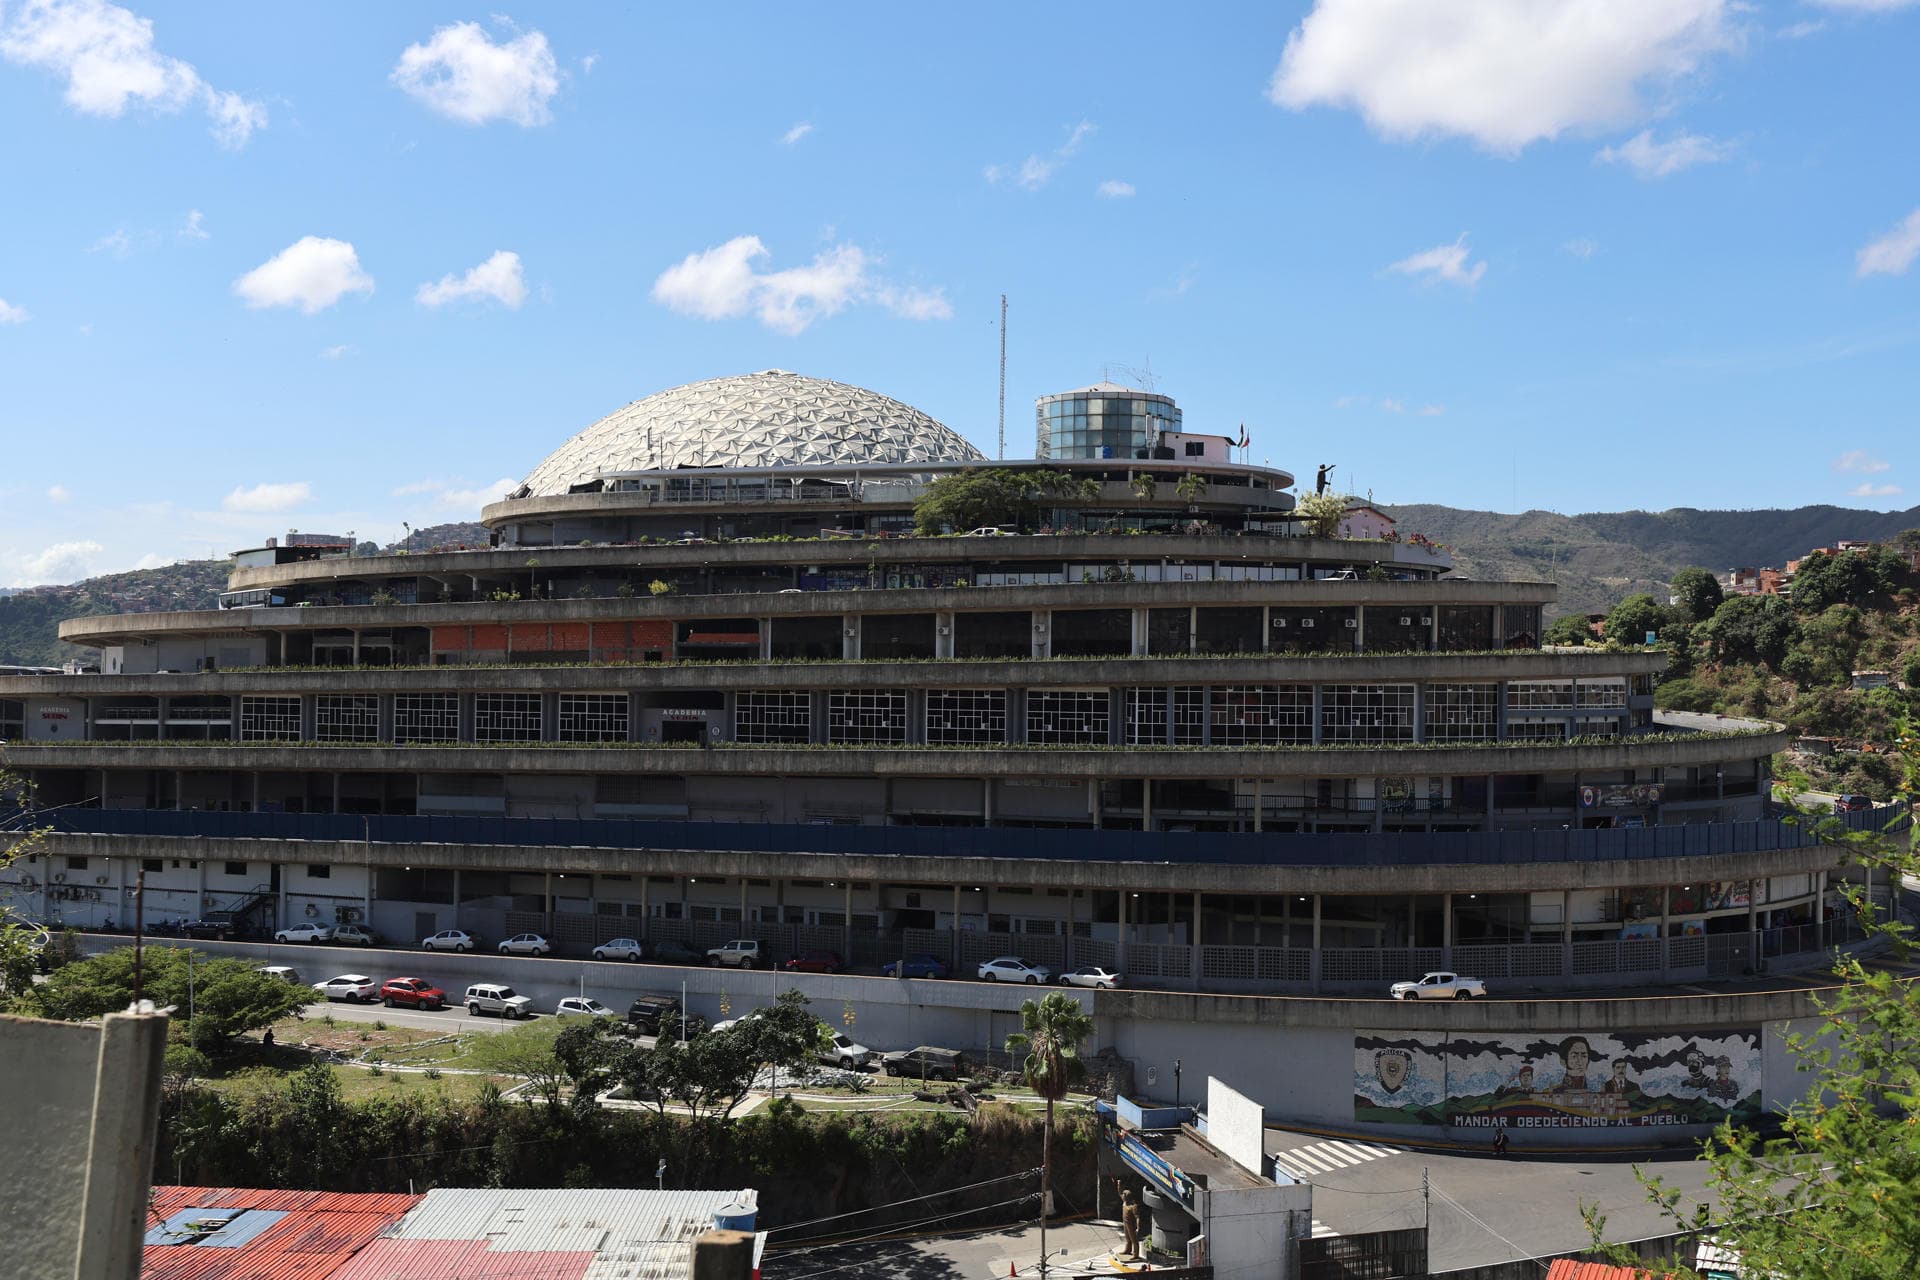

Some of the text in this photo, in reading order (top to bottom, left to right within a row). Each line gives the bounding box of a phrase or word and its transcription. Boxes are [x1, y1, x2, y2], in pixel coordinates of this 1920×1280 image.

[1455, 1114, 1689, 1127] MANDAR OBEDECIENDO AL PUEBLO
